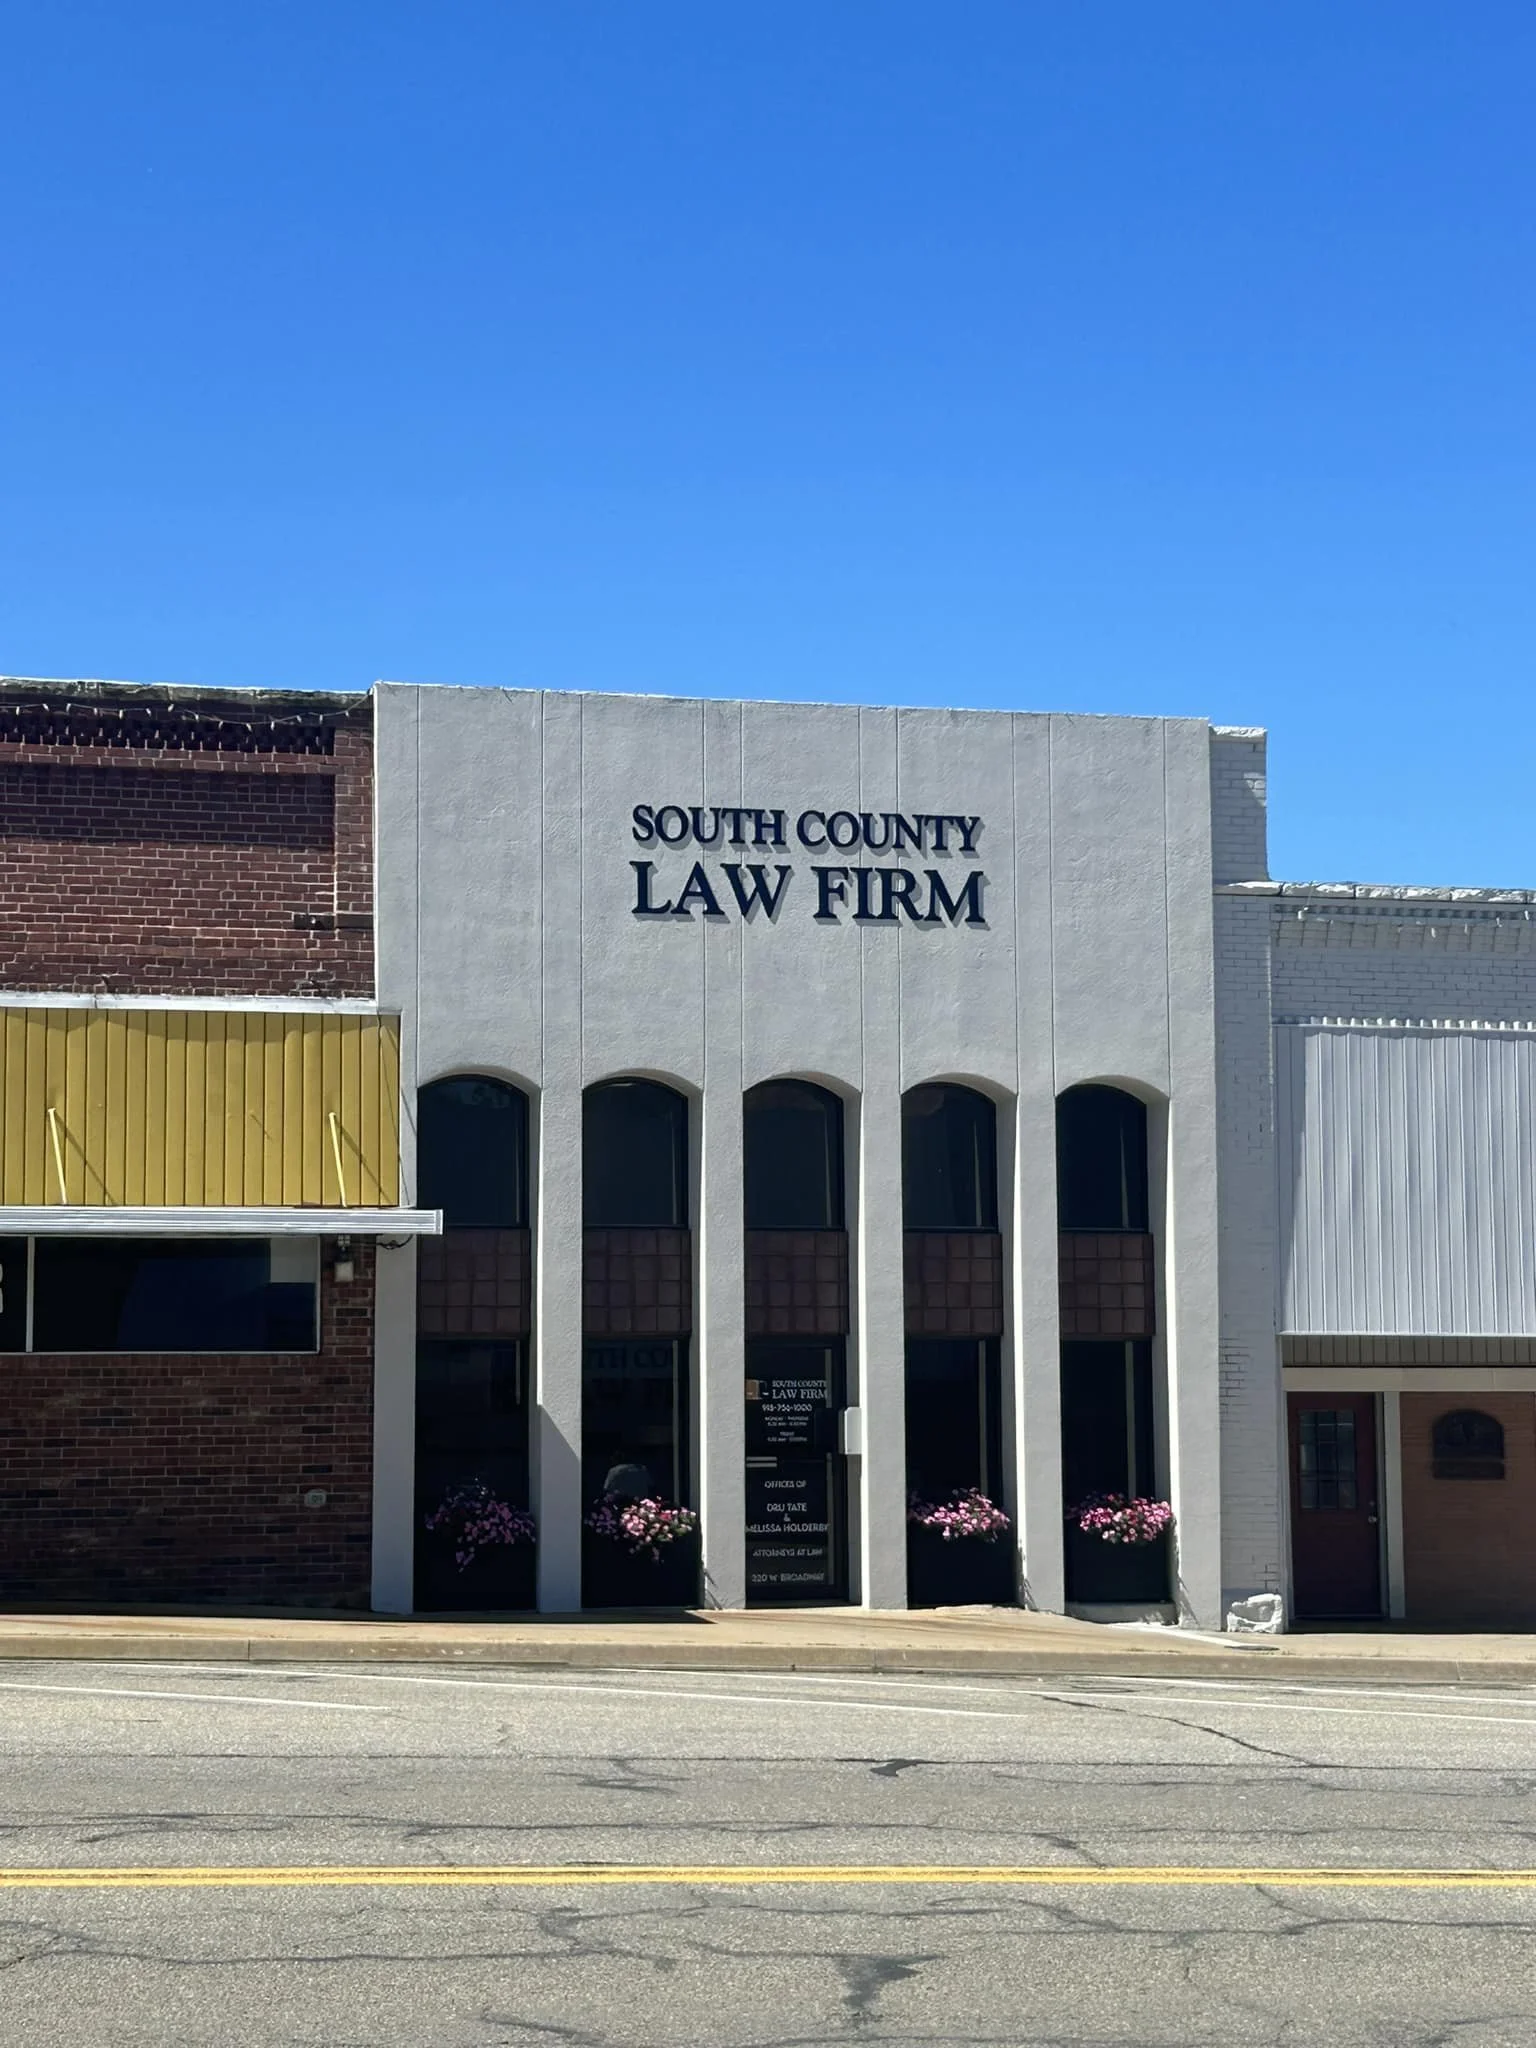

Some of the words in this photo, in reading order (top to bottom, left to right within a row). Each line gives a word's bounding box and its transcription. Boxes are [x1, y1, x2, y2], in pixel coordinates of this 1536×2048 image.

[632, 804, 788, 846] SOUTH
[796, 810, 981, 852] COUNTY
[629, 861, 792, 918] LAW
[810, 866, 985, 923] FIRM
[772, 1380, 797, 1388] SOUTH
[772, 1389, 797, 1399] LAW
[800, 1389, 828, 1399] FIRM
[764, 1480, 795, 1488] OFFICES
[787, 1503, 807, 1512] TATE
[745, 1524, 782, 1533] MELISSA
